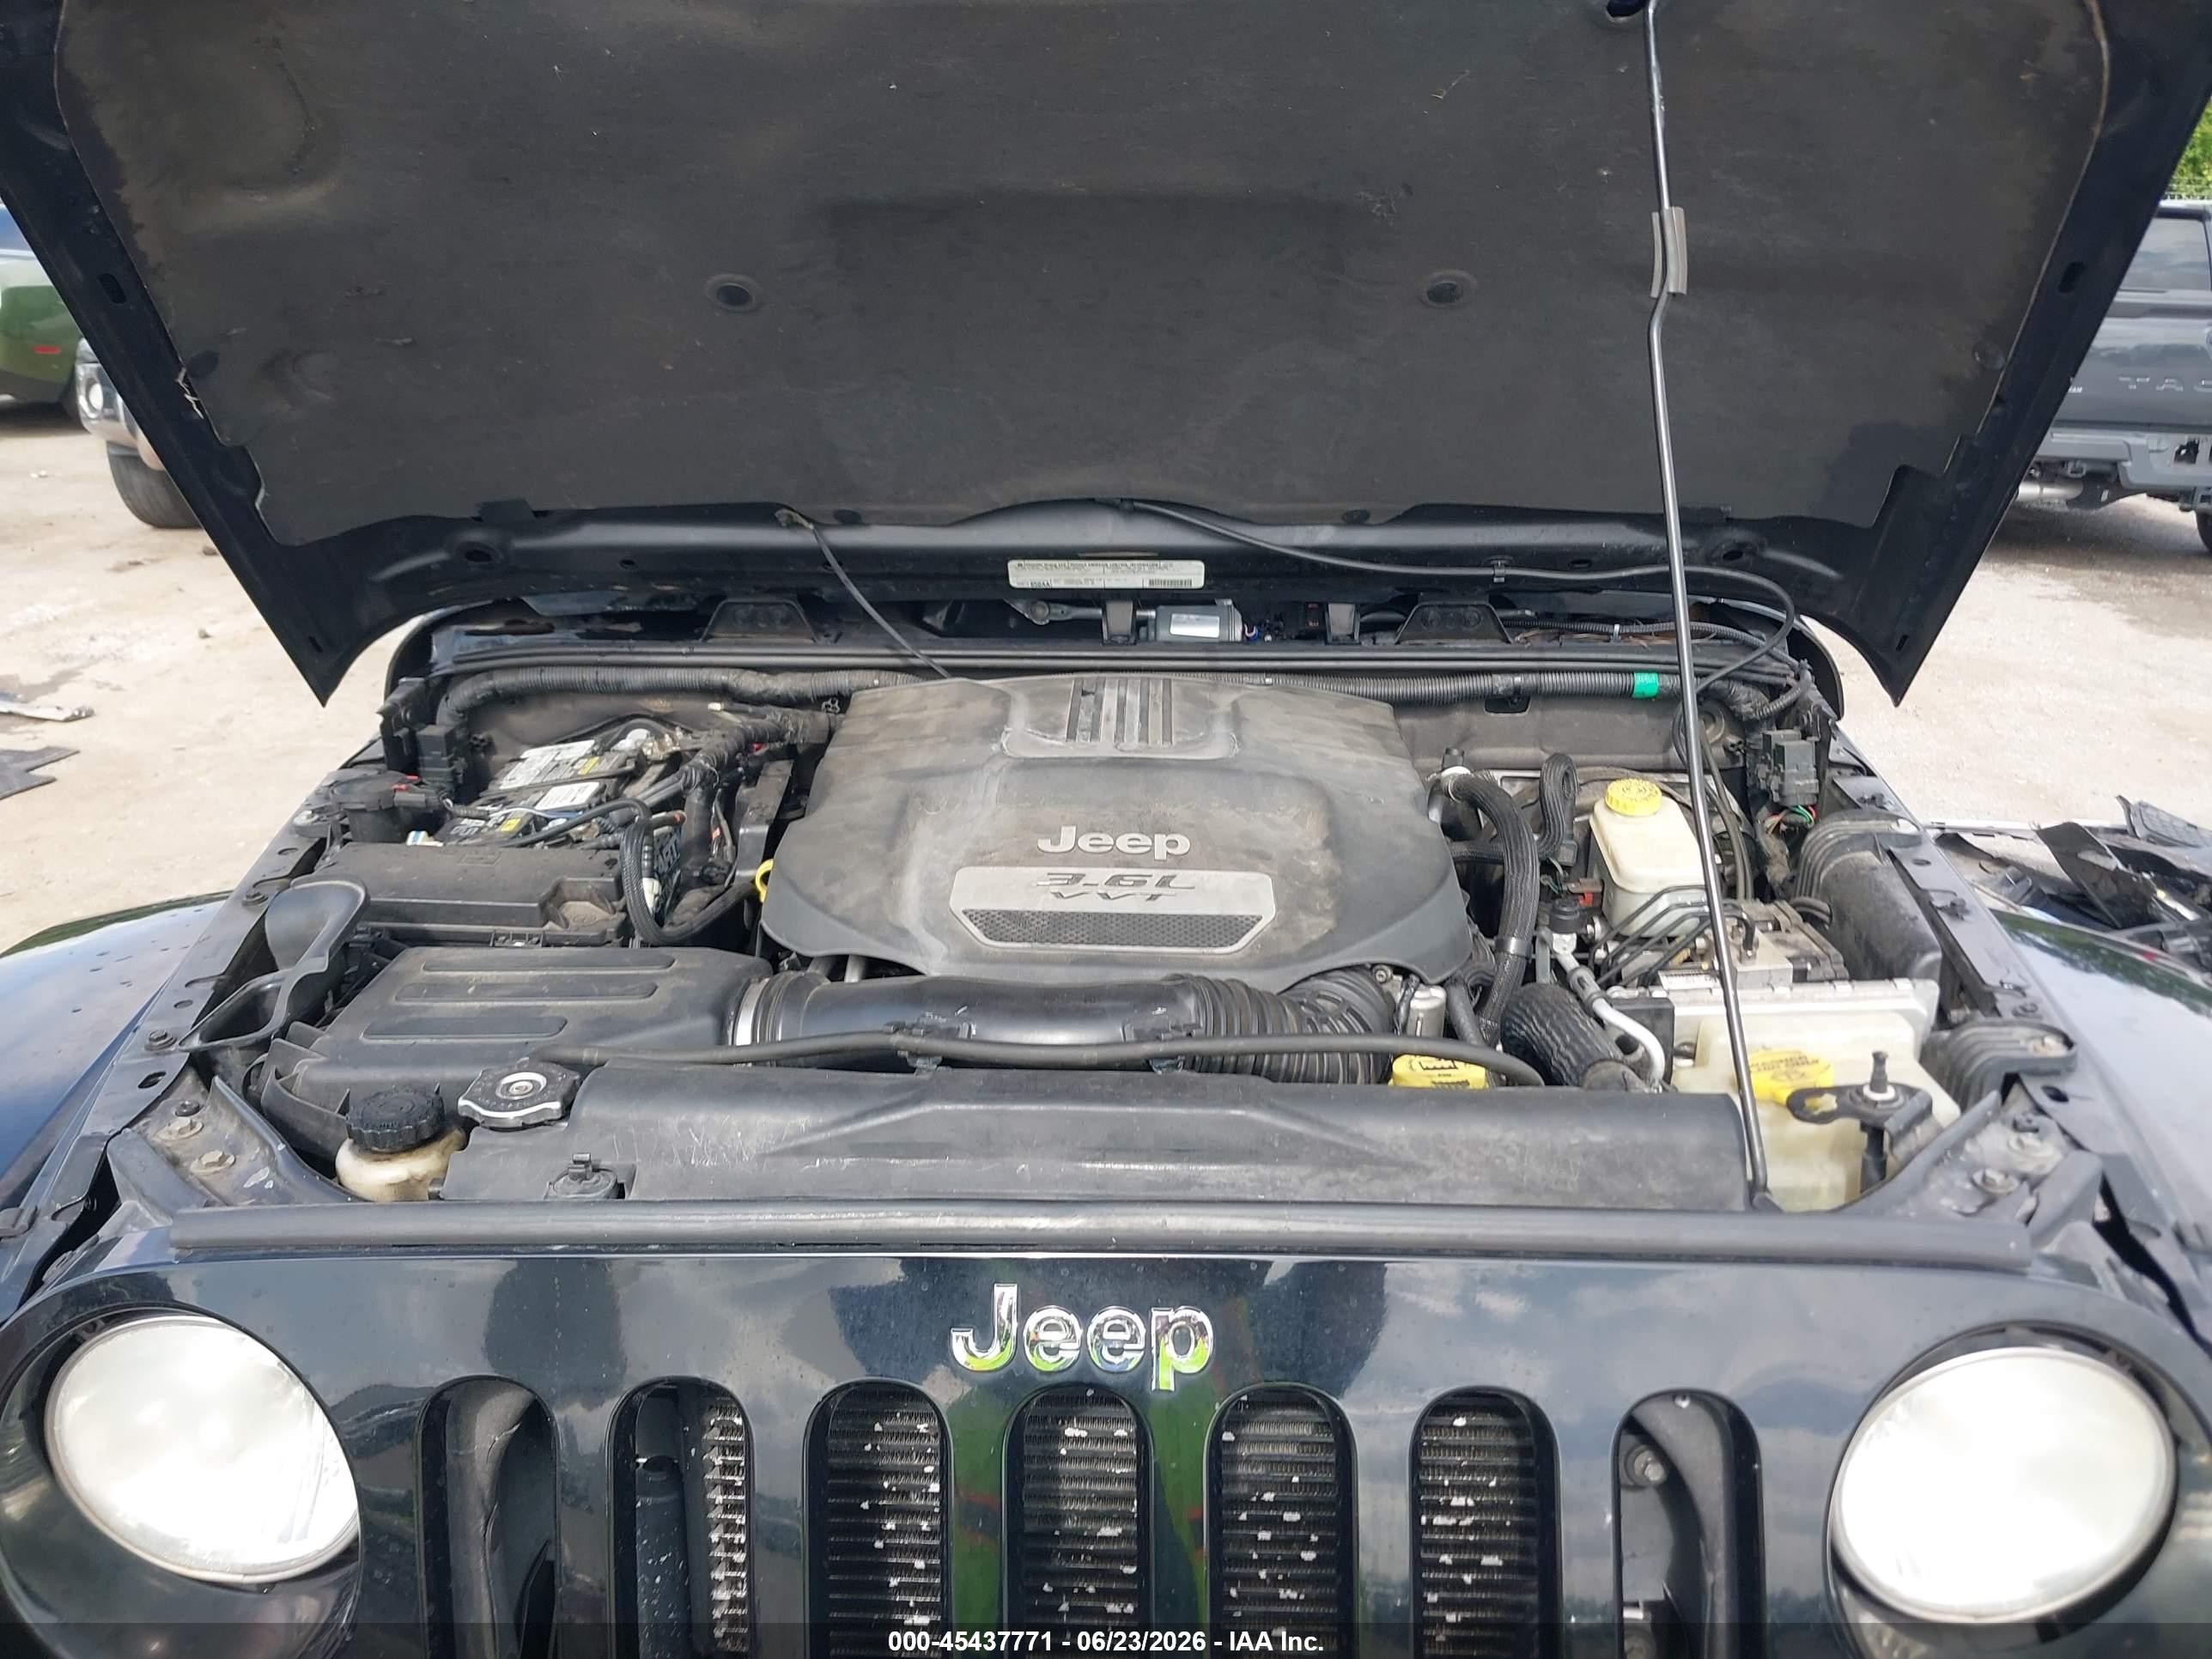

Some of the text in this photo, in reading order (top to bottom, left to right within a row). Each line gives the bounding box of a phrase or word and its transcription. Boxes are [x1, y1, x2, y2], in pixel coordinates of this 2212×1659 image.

[1036, 824, 1191, 860] Jeep
[1035, 872, 1195, 889] 3.6L
[1050, 890, 1177, 902] VVT
[951, 1283, 1213, 1392] Jeep
